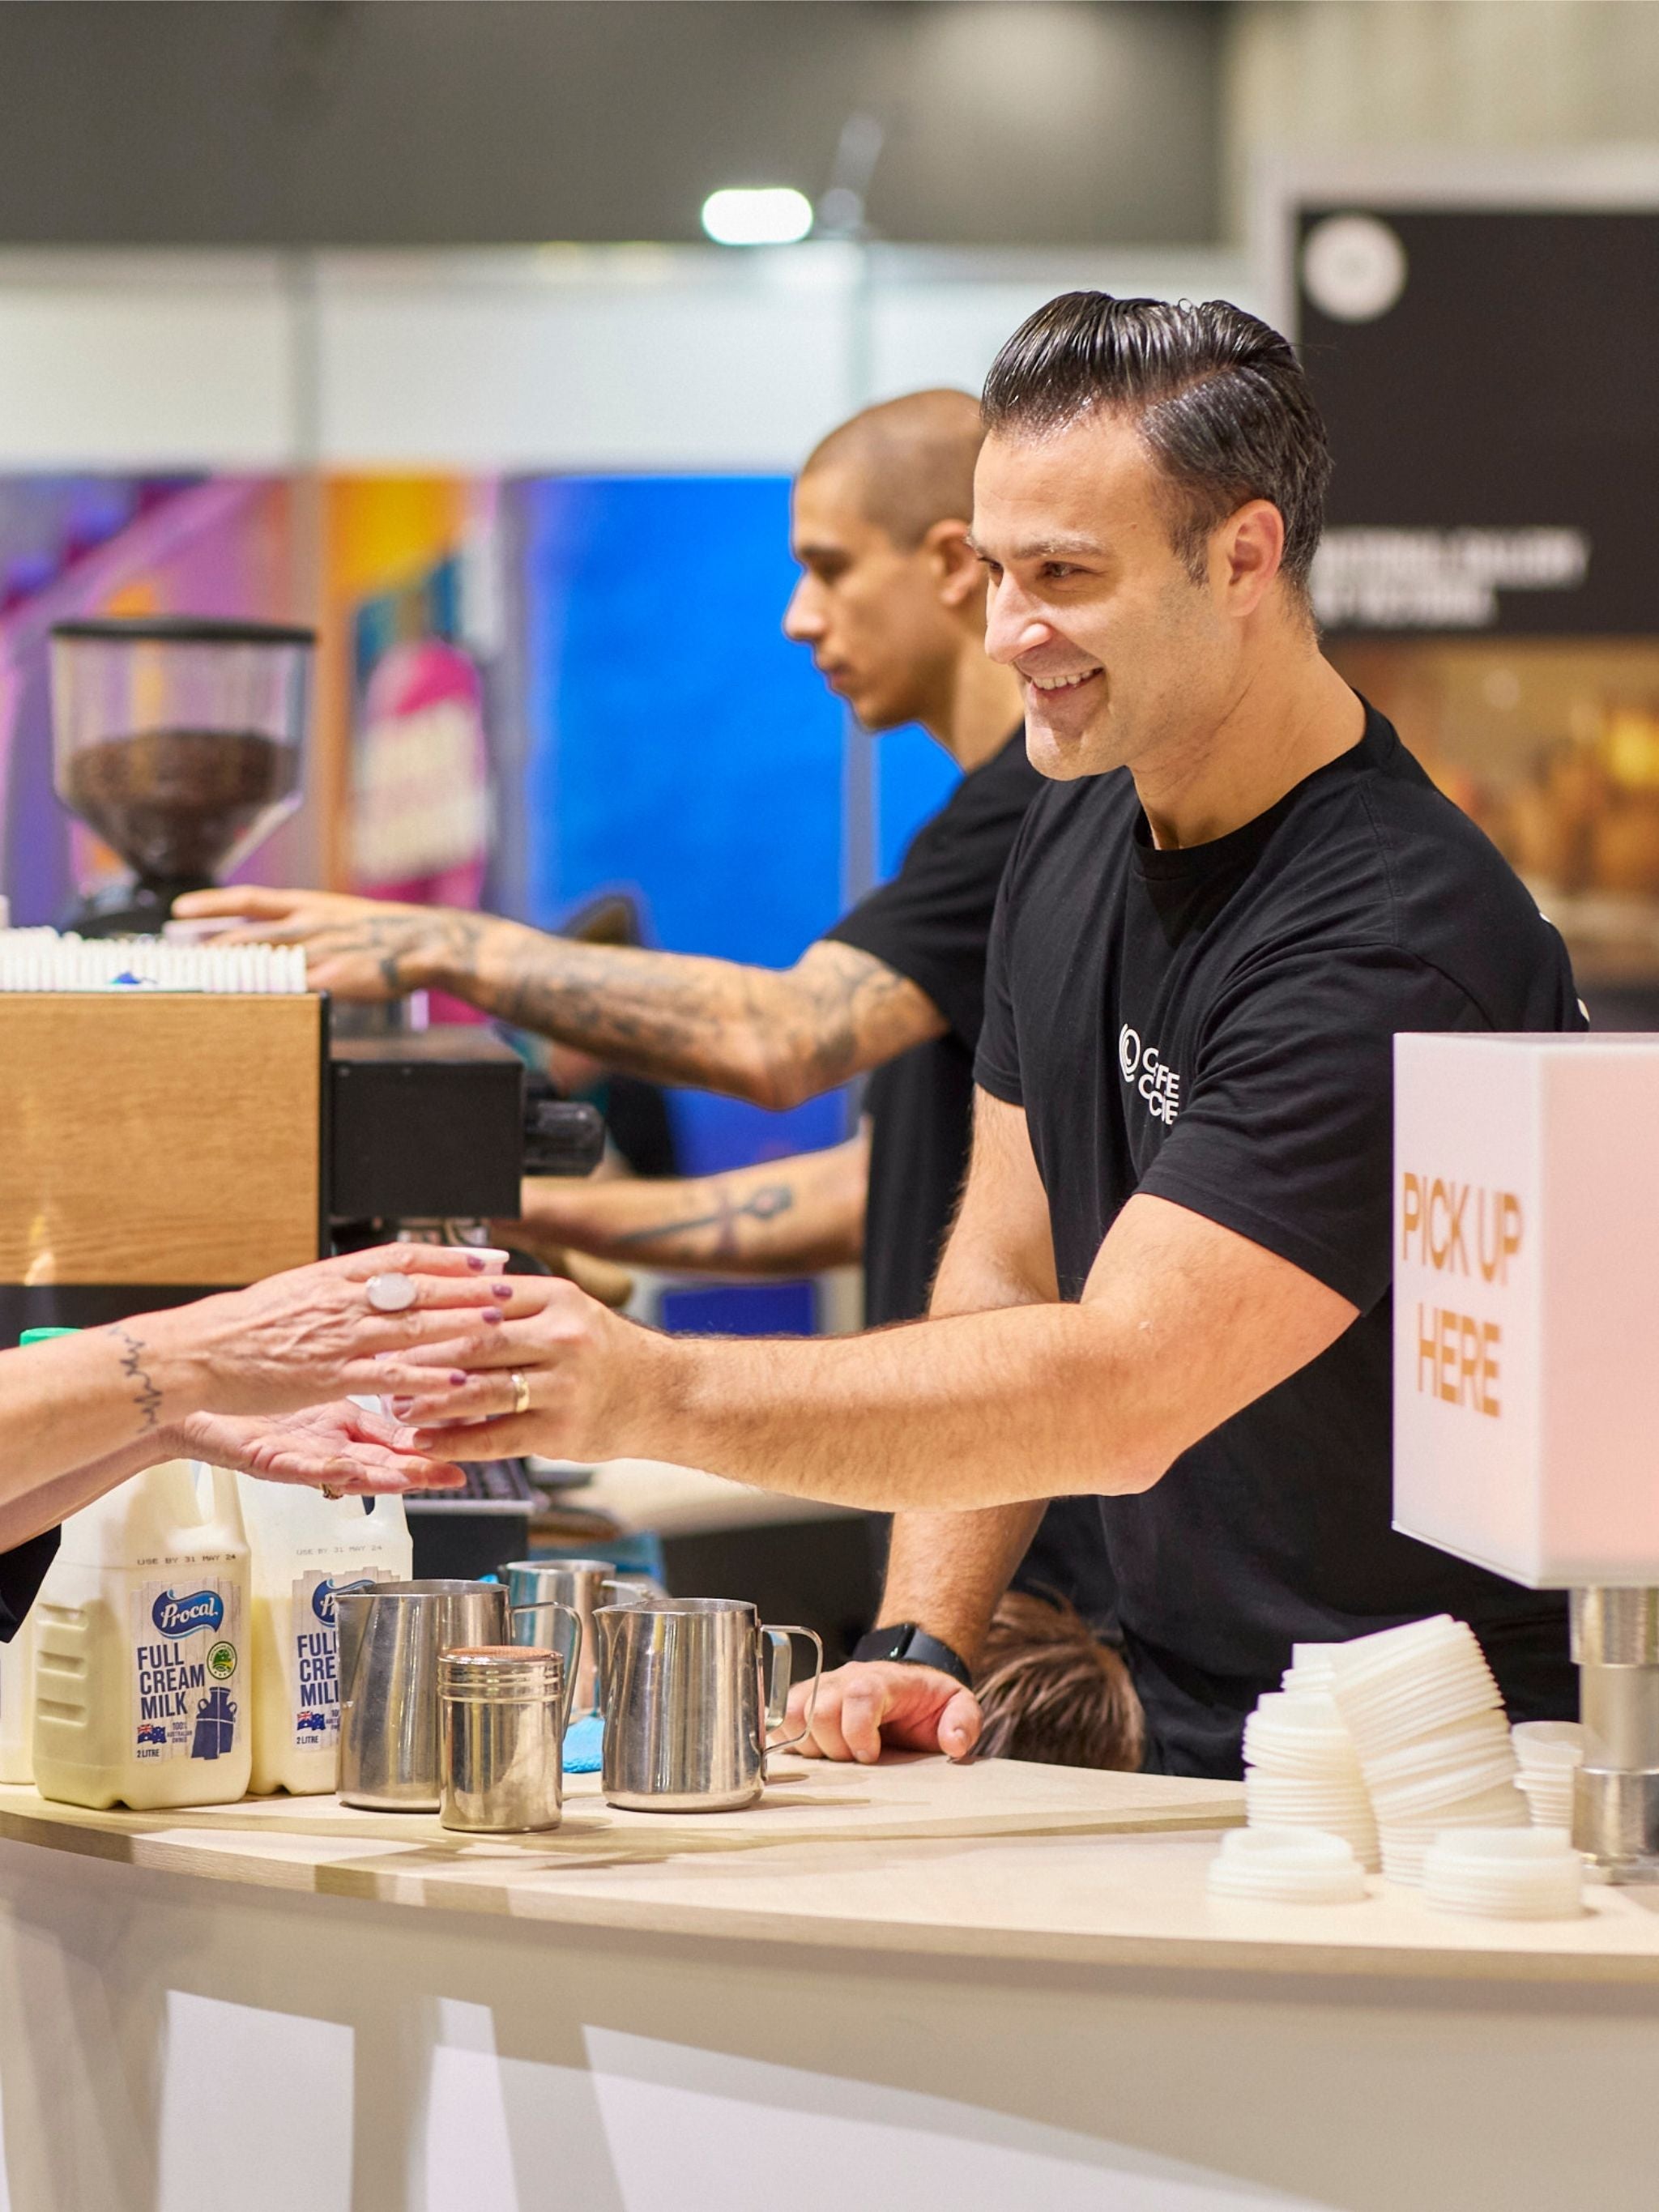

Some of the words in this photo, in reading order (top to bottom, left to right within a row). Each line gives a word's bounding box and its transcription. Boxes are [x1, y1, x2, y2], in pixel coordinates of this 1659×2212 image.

[1403, 1171, 1470, 1277] PICK
[1478, 1187, 1524, 1287] UP
[1418, 1302, 1502, 1417] HERE
[137, 1558, 158, 1566] USE
[137, 1642, 185, 1670] FULL
[300, 1656, 336, 1682] CRE
[139, 1664, 205, 1695] CREAM
[140, 1691, 188, 1720] MILK
[136, 1750, 141, 1758] 2
[142, 1749, 160, 1758] LITRE
[301, 1736, 319, 1744] LITRE
